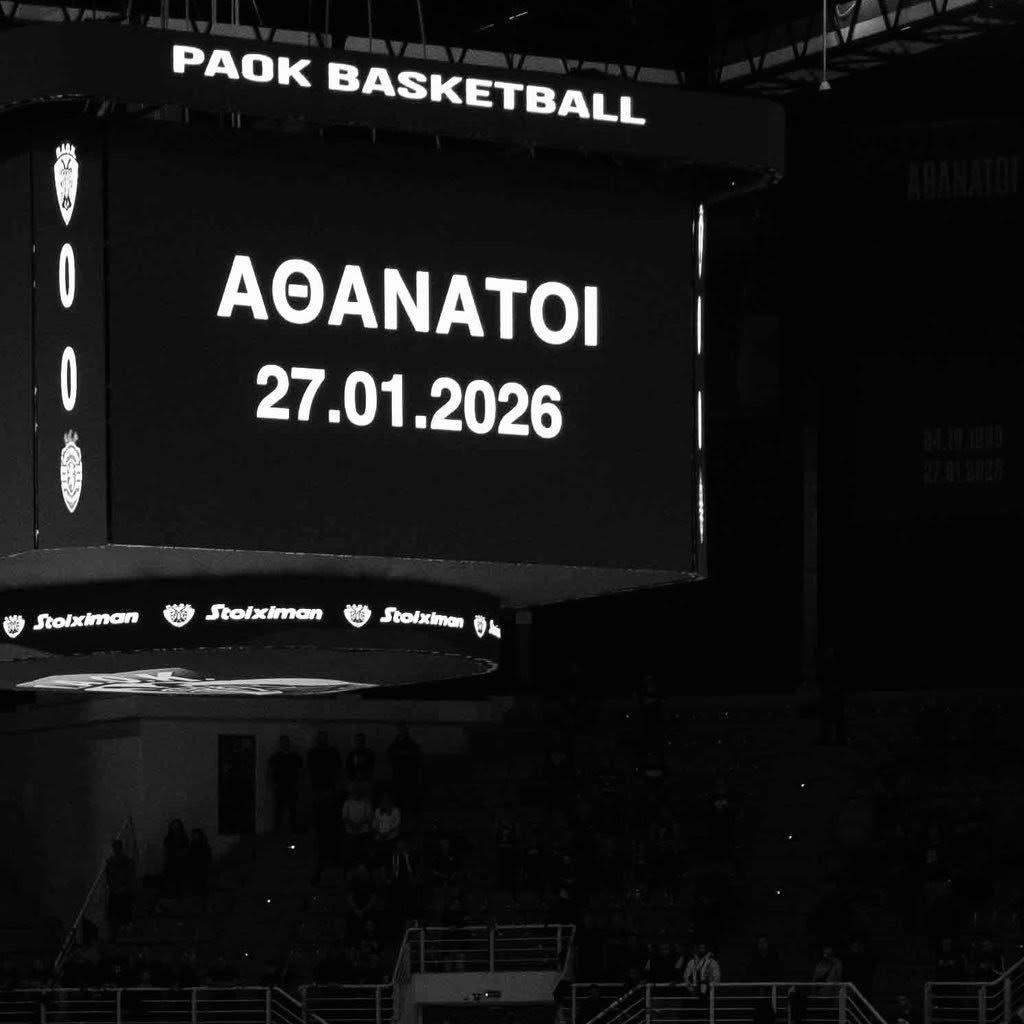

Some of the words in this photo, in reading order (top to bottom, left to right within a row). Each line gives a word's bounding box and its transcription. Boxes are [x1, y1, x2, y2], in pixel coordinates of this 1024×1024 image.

[172, 44, 312, 88] PAOK
[327, 61, 647, 126] BASKETBALL
[58, 242, 76, 309] 0
[216, 254, 598, 347] ΑΘΑΝΑΤΟΙ
[60, 345, 78, 412] 0
[256, 364, 563, 439] 27.01.2026
[32, 610, 140, 631] Stoiximan
[204, 603, 324, 621] Stoiximan
[379, 606, 465, 629] Stoiximan
